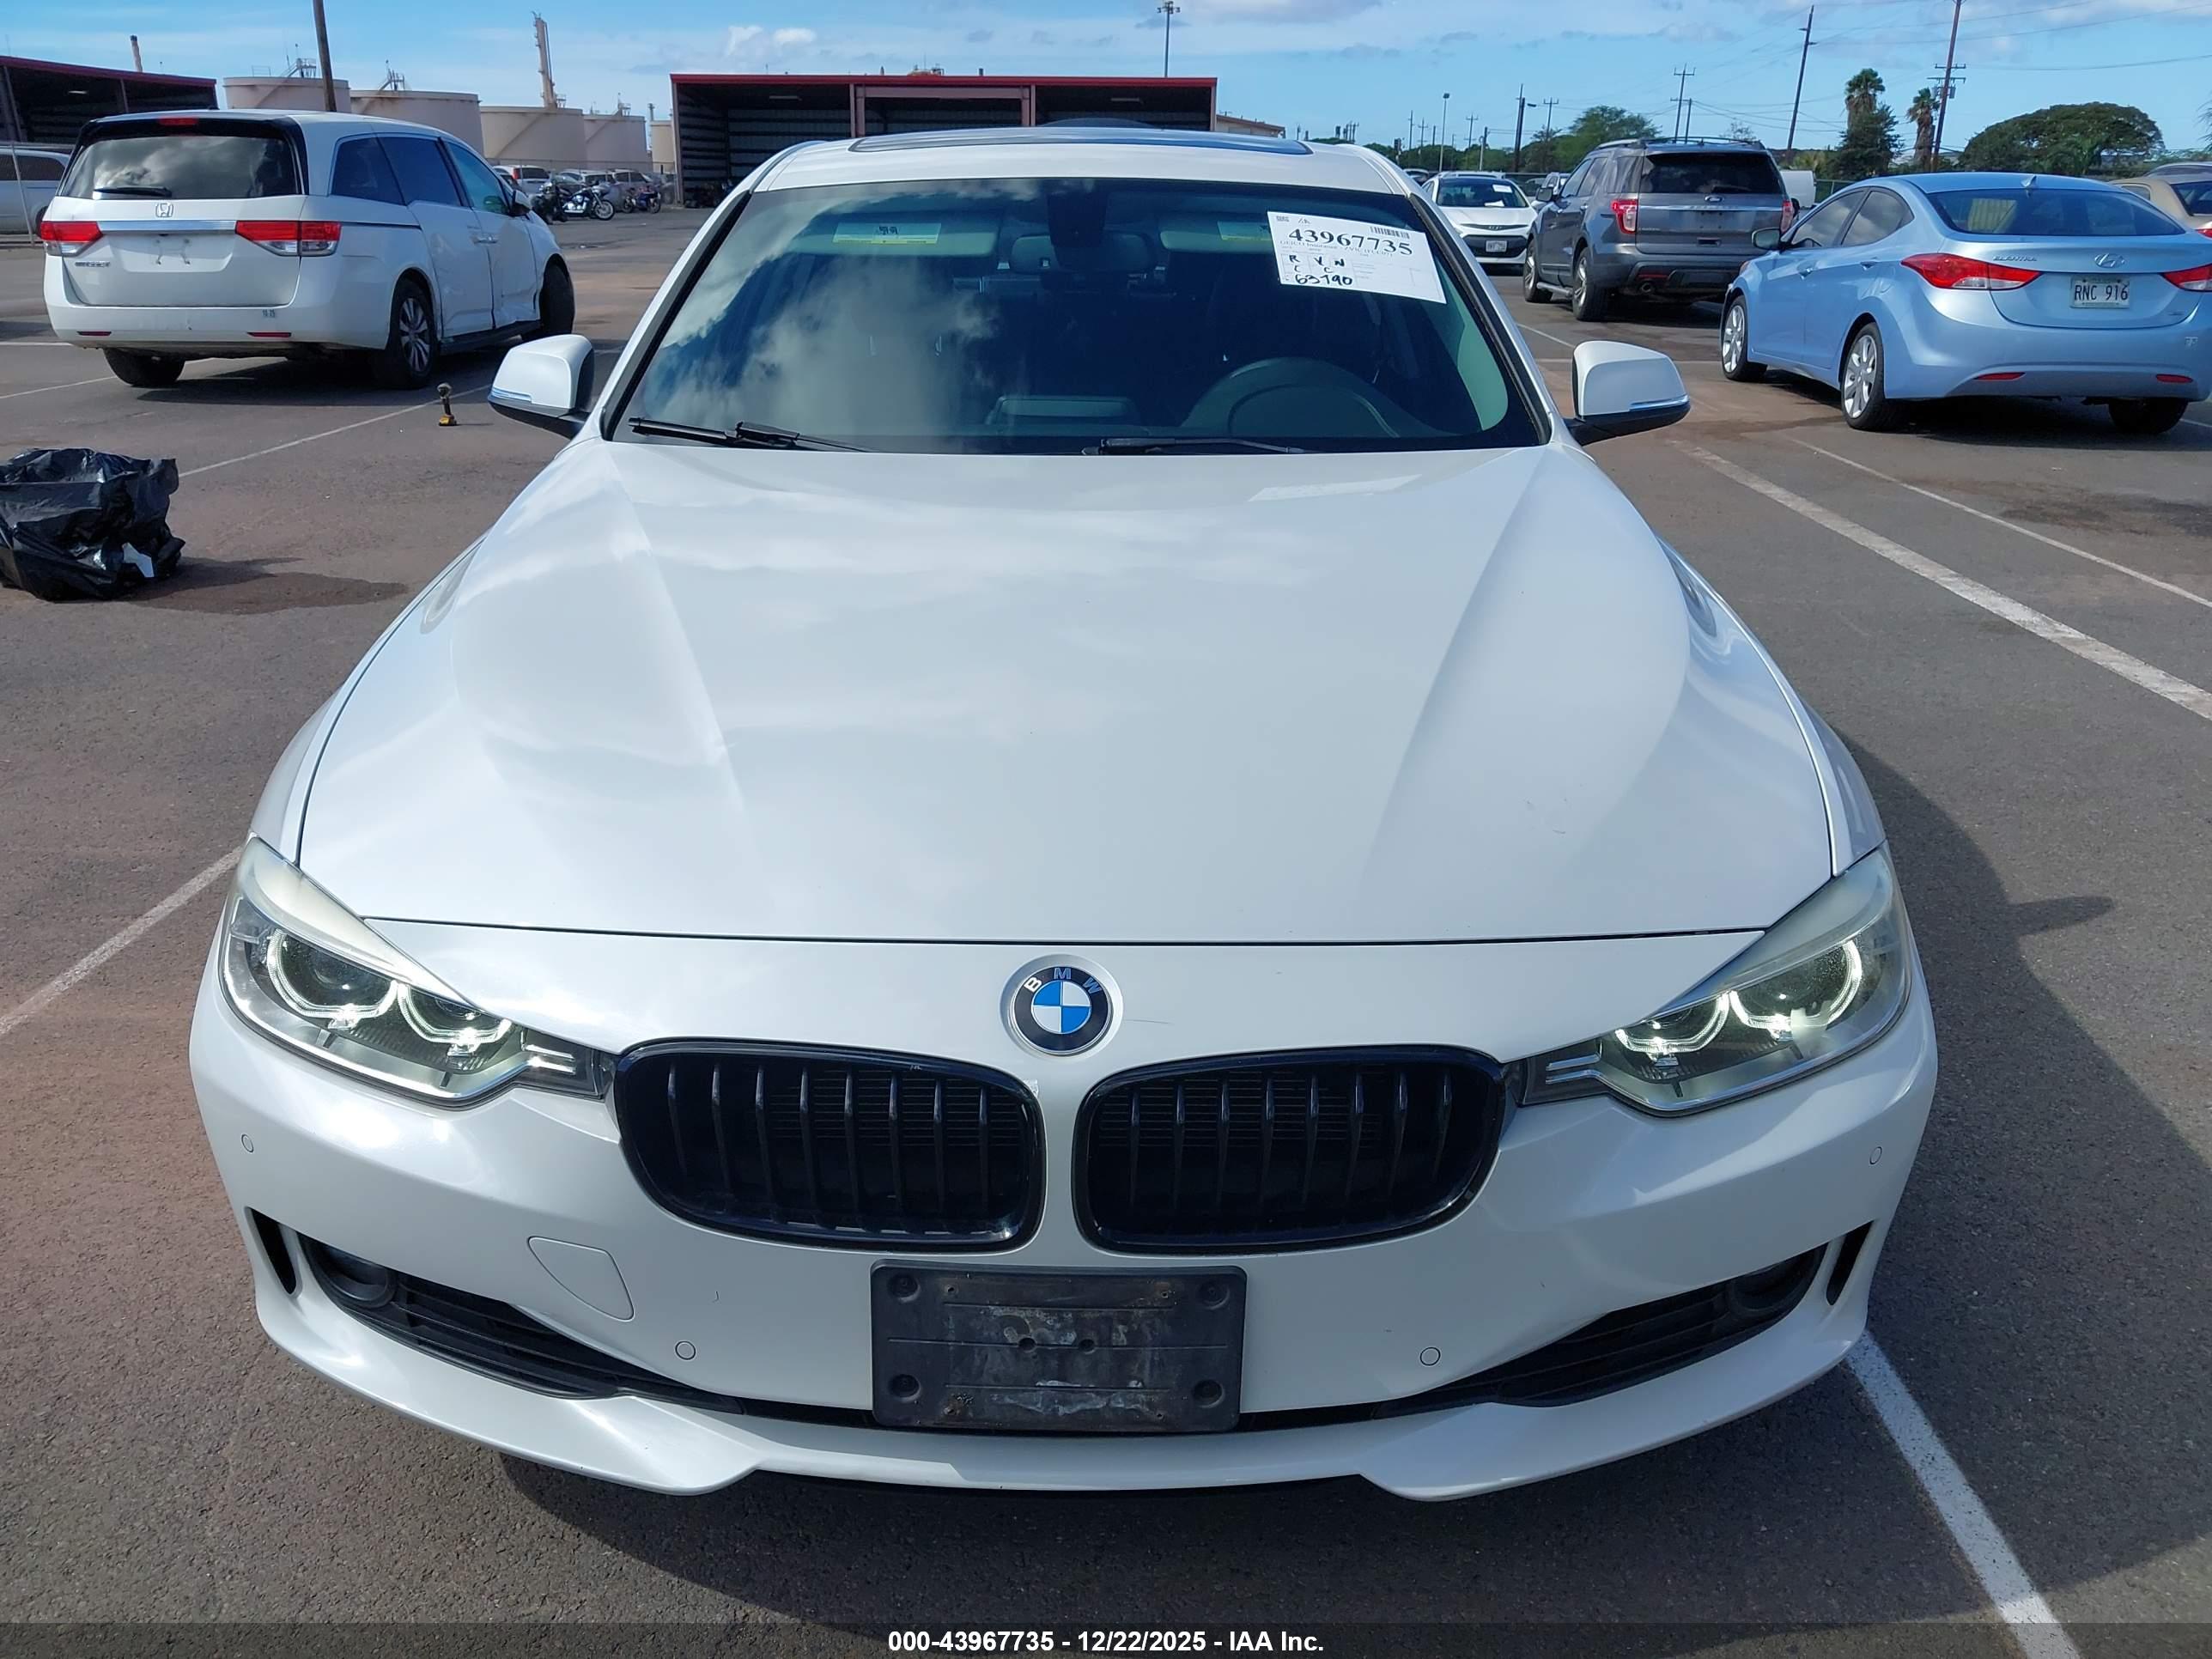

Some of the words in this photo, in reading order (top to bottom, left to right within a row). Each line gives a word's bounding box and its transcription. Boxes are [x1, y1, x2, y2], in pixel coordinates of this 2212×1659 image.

[1289, 228, 1413, 256] 43967735
[1289, 254, 1300, 263] R
[2075, 284, 2097, 301] RNC
[2106, 284, 2129, 301] 916
[1024, 967, 1103, 994] BMW
